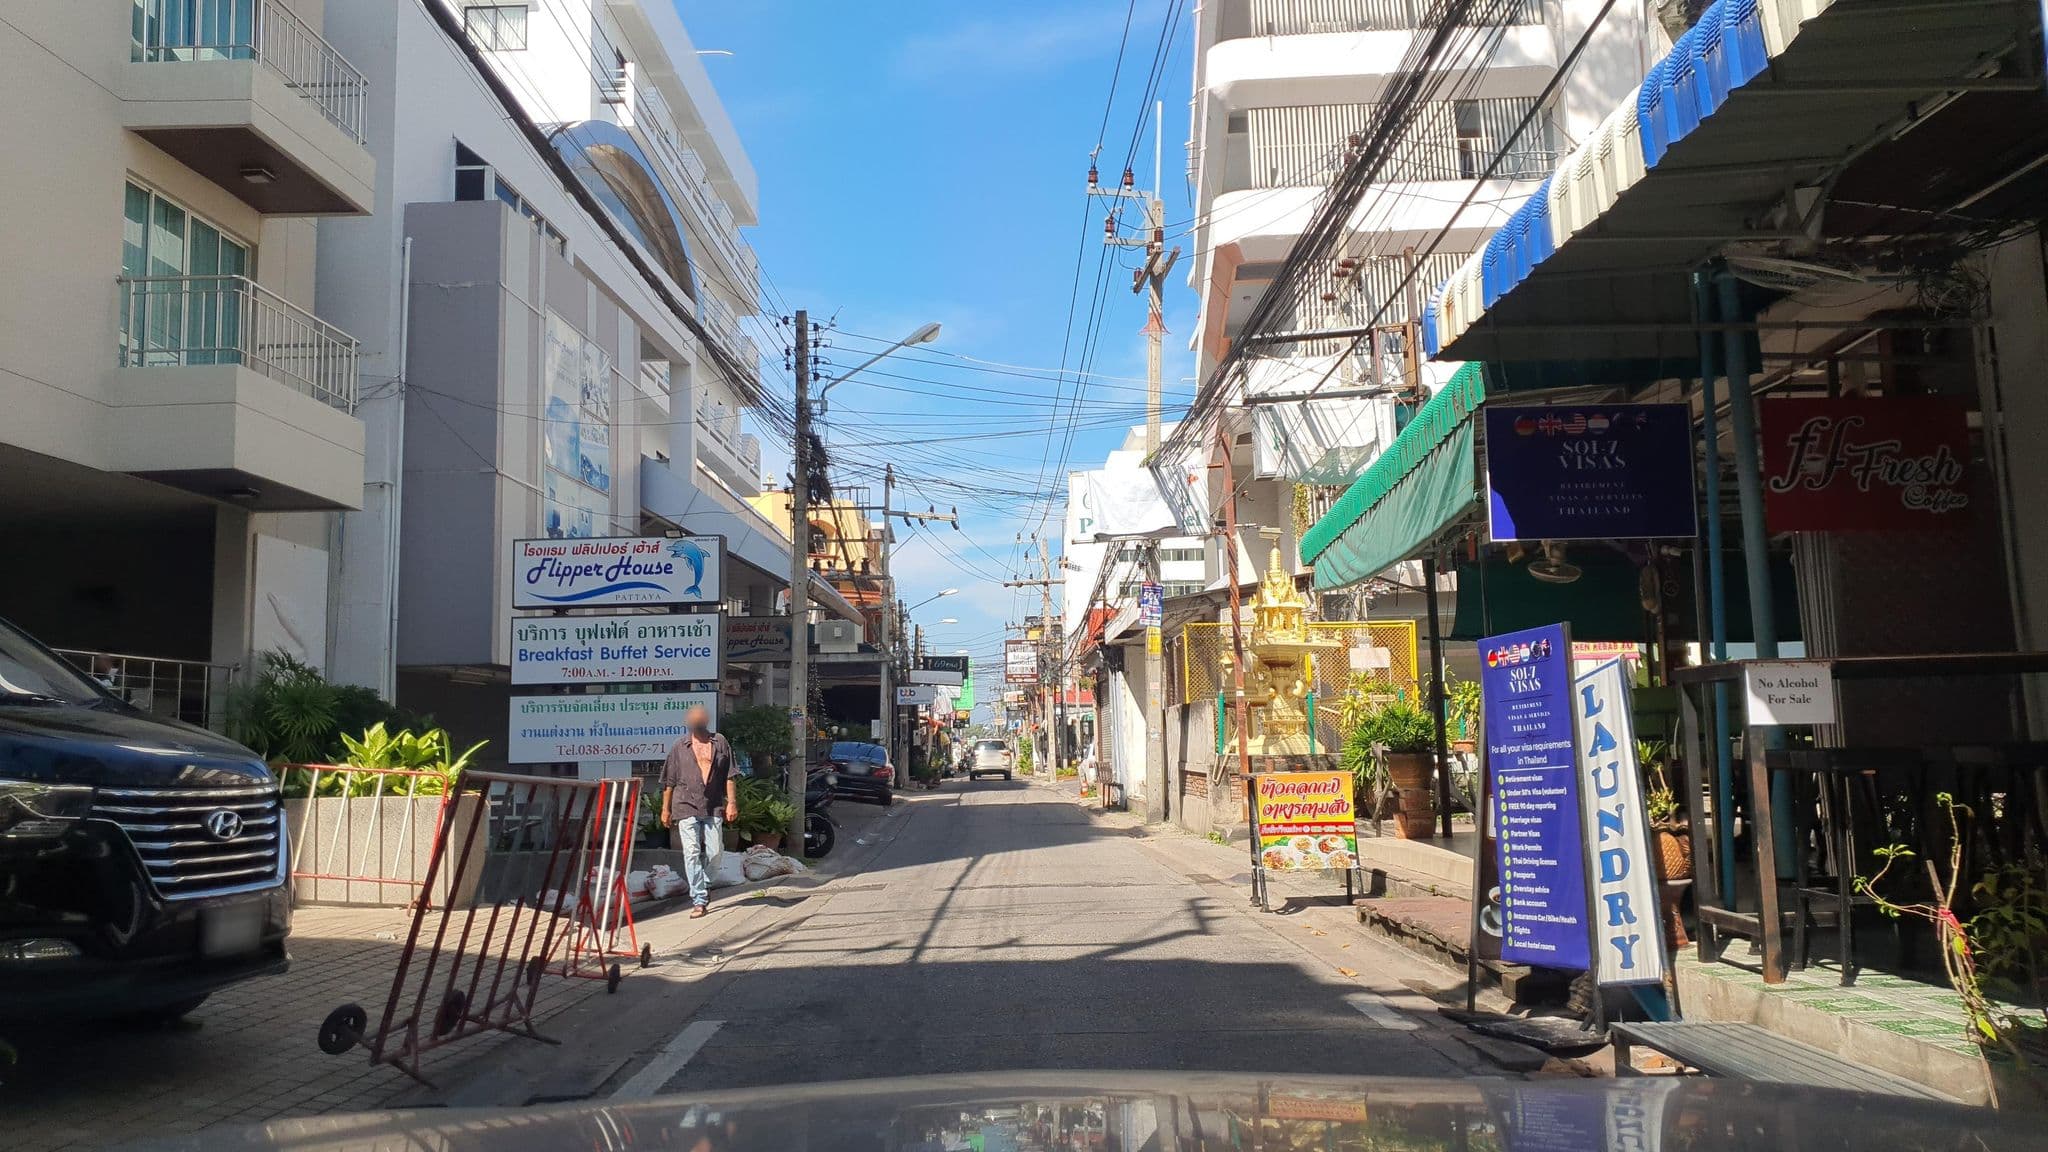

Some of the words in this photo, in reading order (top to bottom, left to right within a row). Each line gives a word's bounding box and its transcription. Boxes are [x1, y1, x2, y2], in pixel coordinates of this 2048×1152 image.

[1562, 440, 1619, 455] SOI-7
[1558, 455, 1627, 470] VISAS
[1844, 439, 1962, 493] Fresh
[1902, 485, 1968, 513] Coffee
[1560, 506, 1631, 516] THAILAND
[524, 543, 566, 557] โรงแรม
[572, 542, 630, 556] ฟลิปเปอร์
[633, 540, 662, 555] เฮ้าส์
[526, 557, 604, 587] Flipper
[605, 555, 673, 582] House
[615, 593, 662, 601] PATTAYA
[517, 624, 567, 641] บริการ
[638, 619, 712, 639] อาหารเช้า
[518, 647, 594, 662] Breakfast
[601, 646, 648, 660] Buffet
[654, 644, 711, 659] Service
[561, 667, 610, 678] 7:00A.M.
[620, 666, 674, 678] 12:00P.M.
[1510, 666, 1536, 681] SOI-7
[1510, 678, 1541, 693] VISAS
[1758, 678, 1773, 688] No
[1777, 677, 1818, 688] Alcohol
[520, 695, 615, 714] บริการรับจัดเลี้ยง
[620, 700, 659, 715] ประชุม
[1768, 694, 1786, 704] For
[1789, 693, 1812, 704] Sale
[520, 724, 585, 737] งานแต่งงาน
[1512, 722, 1546, 732] THAILAND
[1491, 745, 1499, 754] For
[1507, 745, 1520, 754] your
[1521, 742, 1532, 751] visa
[1533, 740, 1571, 752] requirements
[1517, 756, 1524, 765] in
[1524, 754, 1547, 765] Thailand
[1261, 777, 1341, 800] ข้าวคลุกกะปิ
[1262, 794, 1350, 820] อาหารตามสั่ง
[1581, 684, 1640, 969] LAUNDRY
